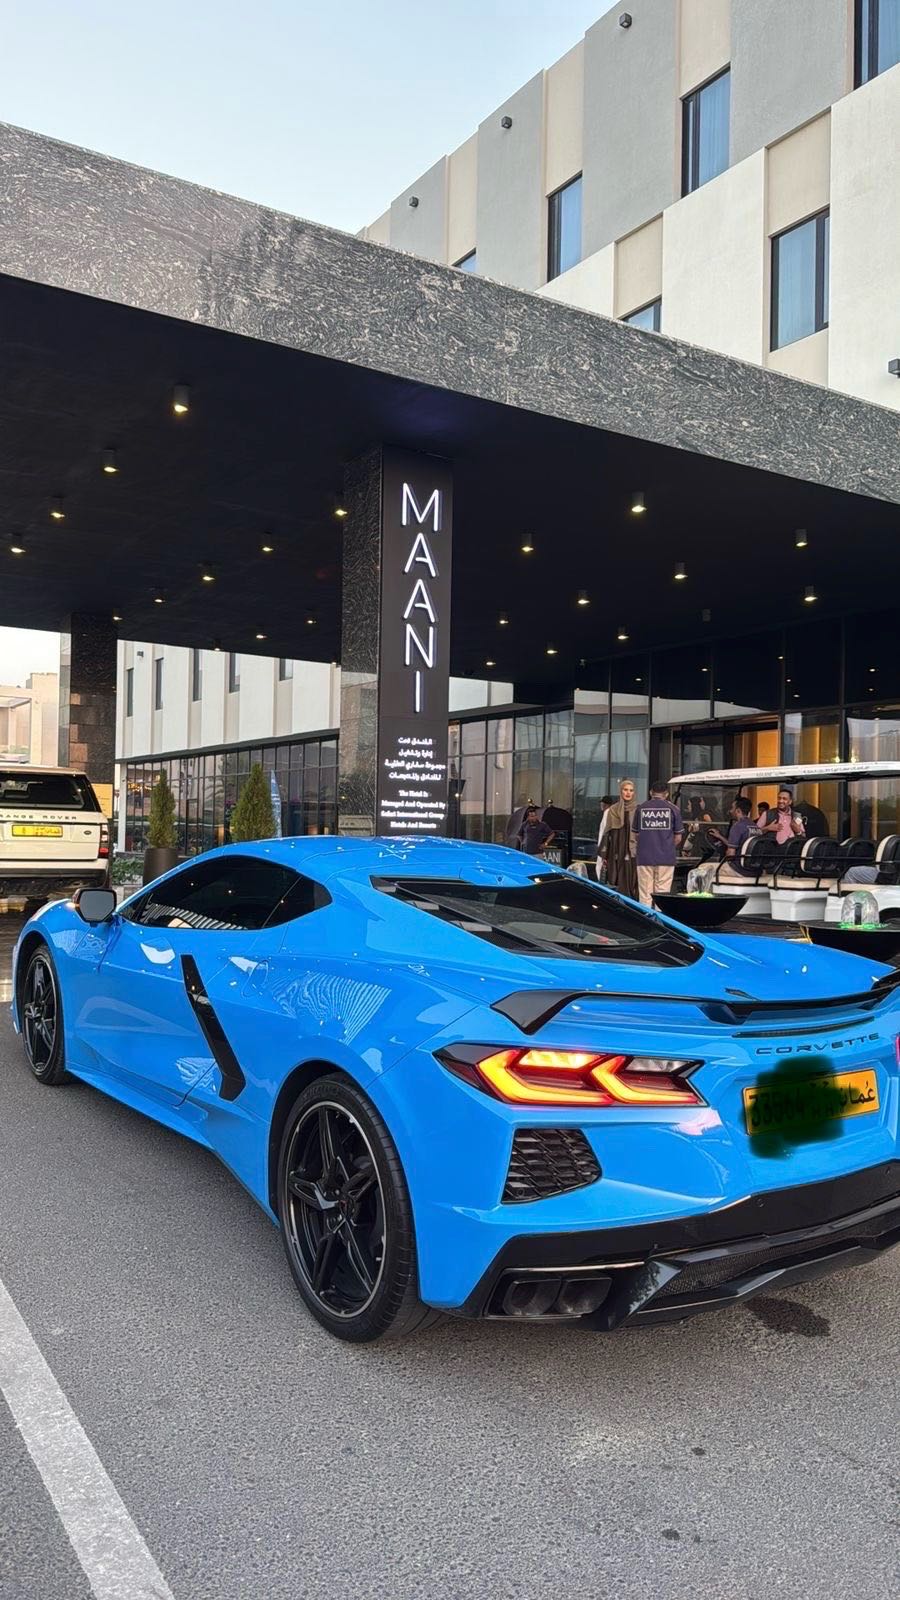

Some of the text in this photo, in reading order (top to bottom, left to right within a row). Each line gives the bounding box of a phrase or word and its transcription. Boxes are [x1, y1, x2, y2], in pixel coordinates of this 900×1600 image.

[401, 482, 438, 713] MAANI
[543, 851, 561, 863] AANI
[755, 1032, 880, 1055] CORVETTE
